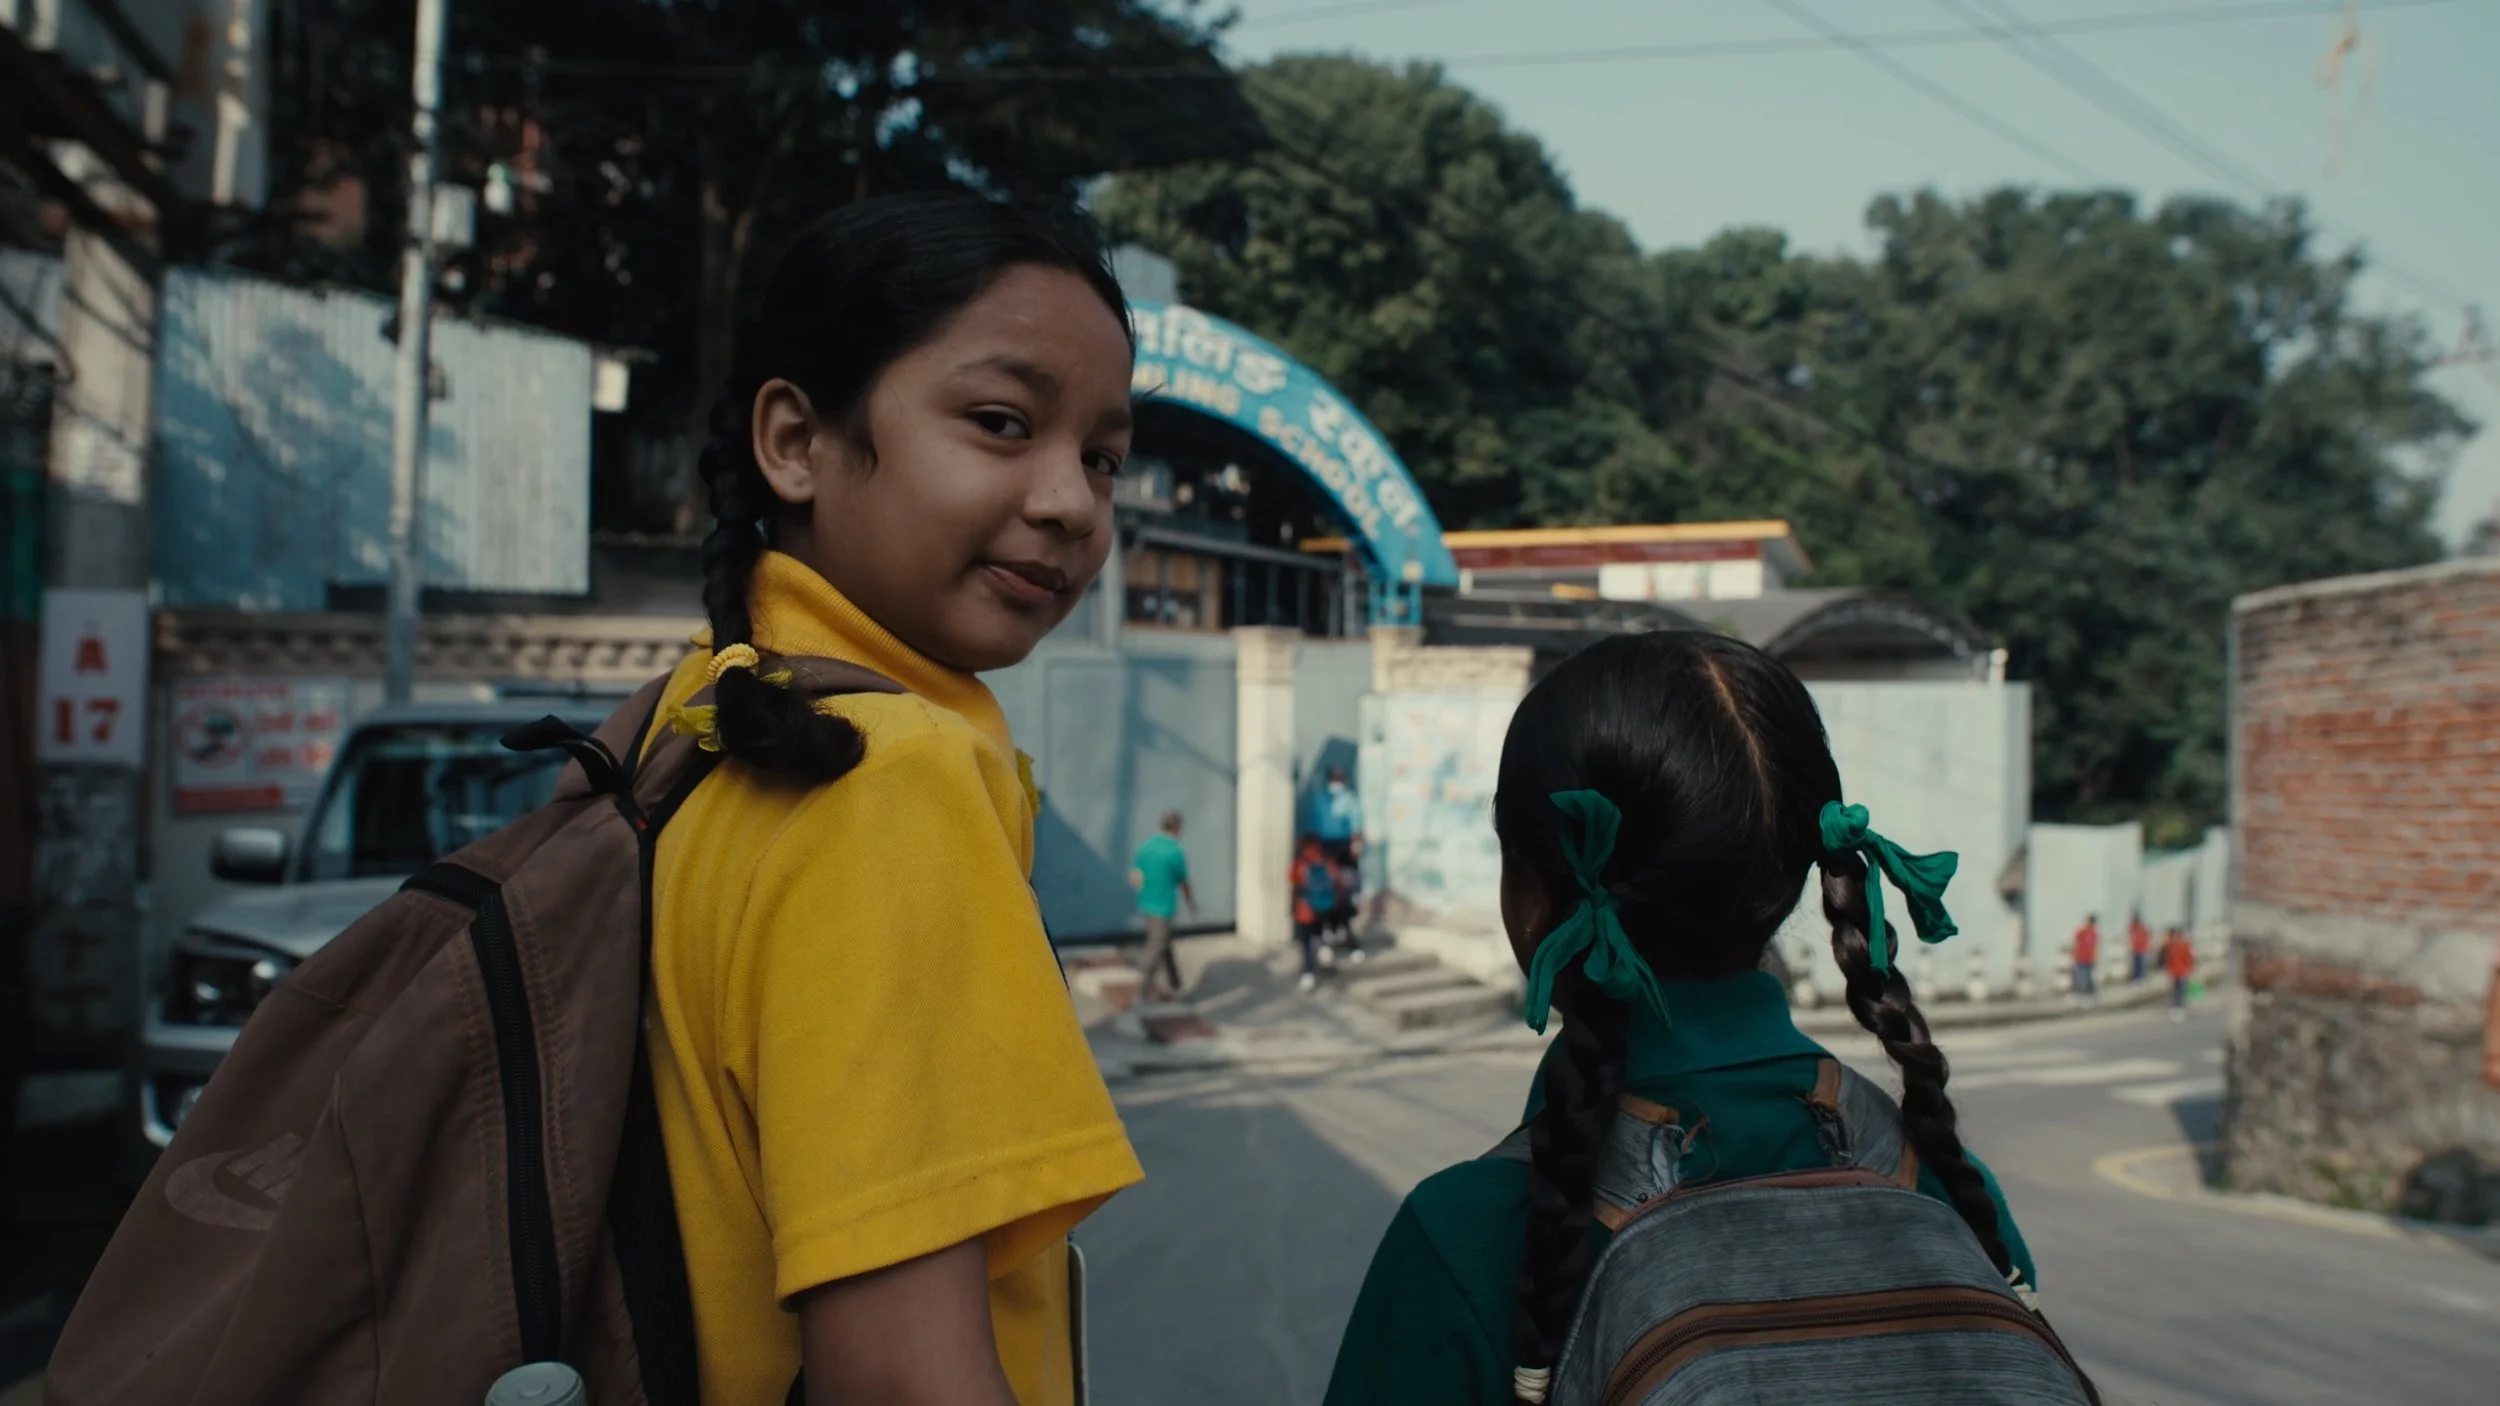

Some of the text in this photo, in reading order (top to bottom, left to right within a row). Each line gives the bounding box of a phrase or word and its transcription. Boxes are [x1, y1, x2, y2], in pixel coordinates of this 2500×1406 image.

[1258, 406, 1381, 540] SCHOOL
[75, 636, 108, 675] A
[55, 697, 120, 744] 17
